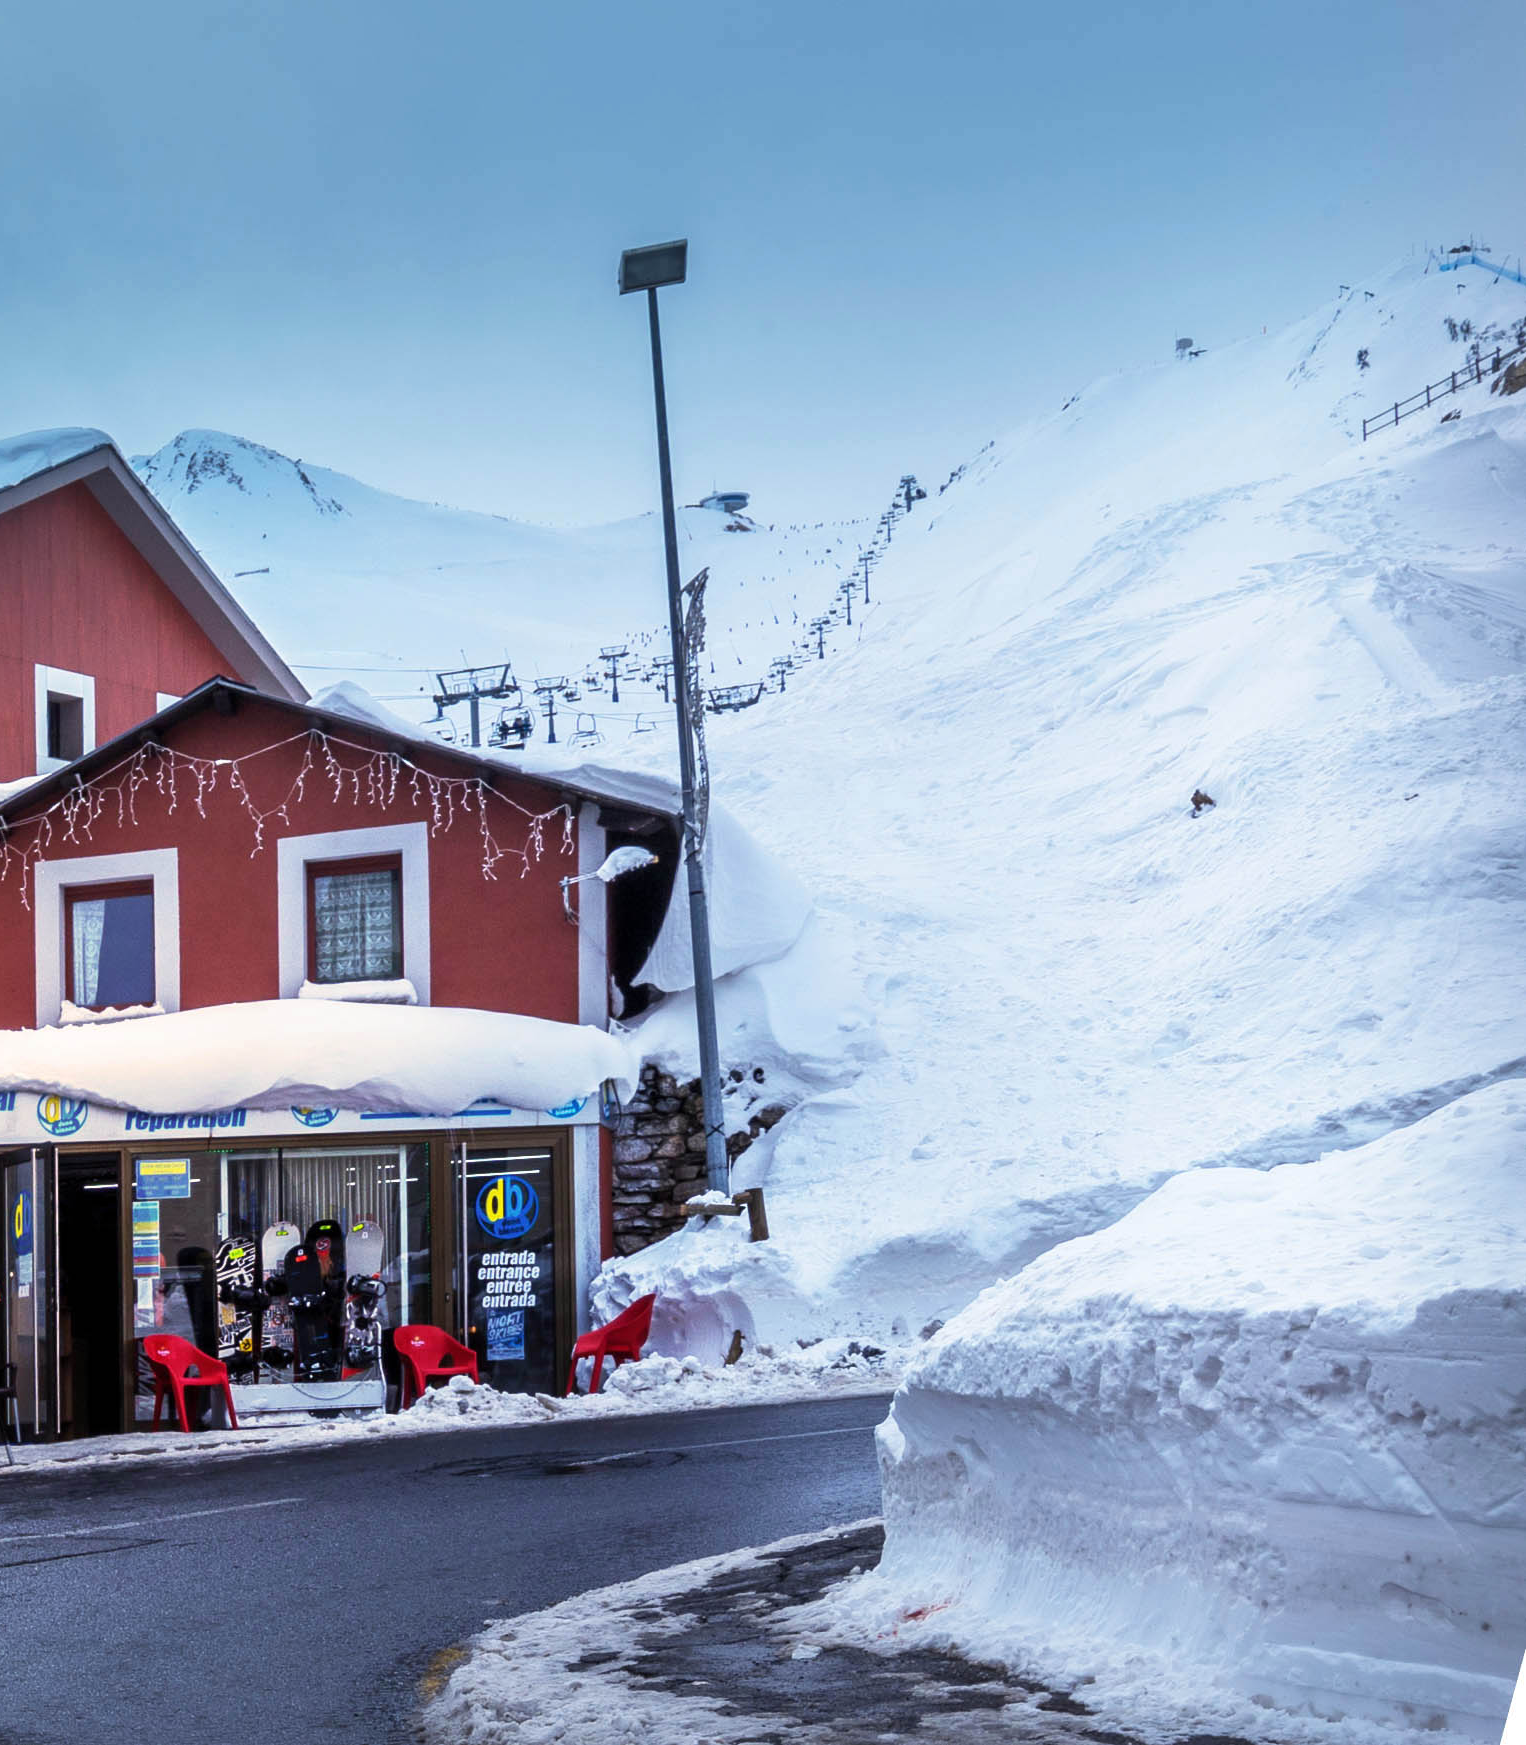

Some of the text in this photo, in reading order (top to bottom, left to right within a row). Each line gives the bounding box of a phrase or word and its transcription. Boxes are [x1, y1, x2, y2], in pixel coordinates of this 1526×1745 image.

[485, 1176, 523, 1223] db
[481, 1250, 536, 1266] entrada
[477, 1266, 541, 1280] entrance
[482, 1292, 536, 1308] entrada
